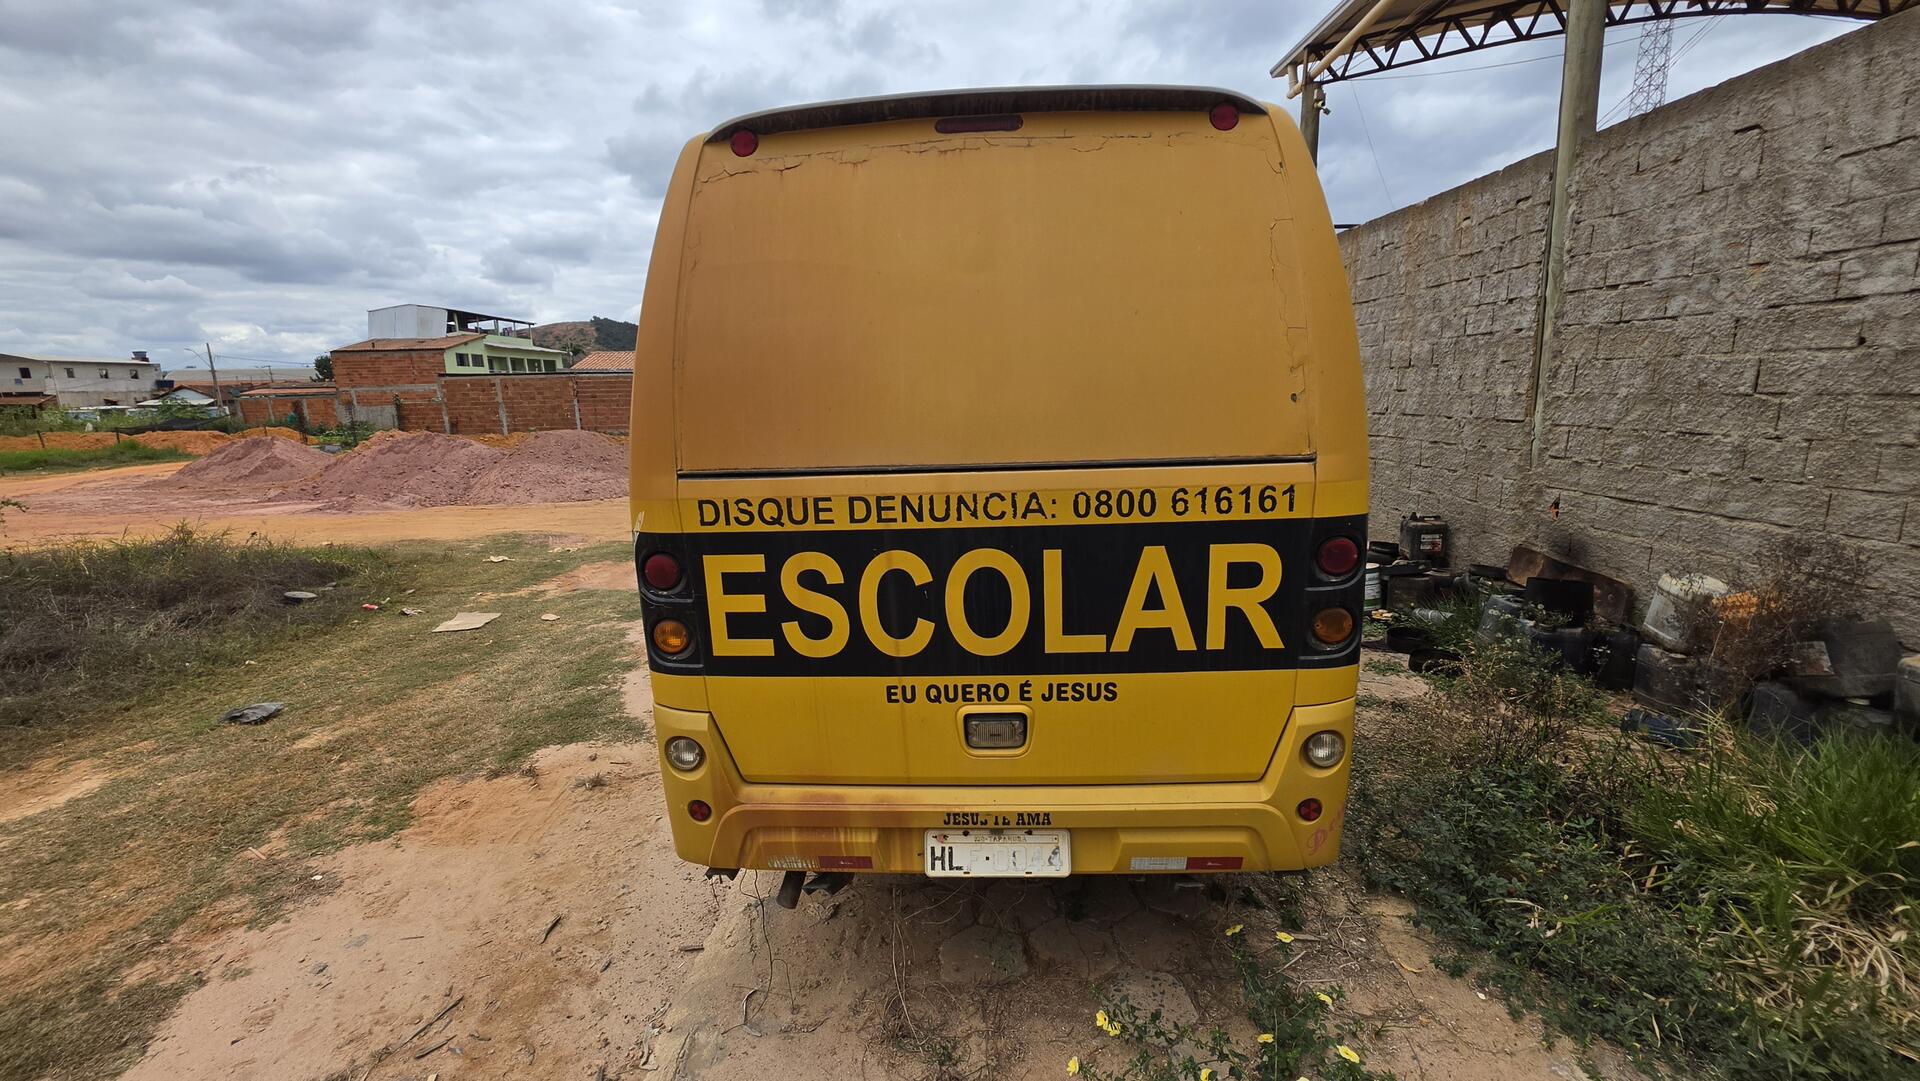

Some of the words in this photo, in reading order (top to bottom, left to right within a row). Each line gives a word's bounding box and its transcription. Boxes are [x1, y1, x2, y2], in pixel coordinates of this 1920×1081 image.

[698, 496, 835, 528] DISQUE
[1072, 488, 1157, 519] 0800
[1170, 484, 1296, 517] 616161
[702, 543, 1285, 657] ESCOLAR
[885, 685, 917, 704] EU
[925, 682, 1010, 705] QUERO
[1019, 679, 1033, 702] É
[1040, 682, 1118, 702] JESUS
[1015, 812, 1052, 827] AMA
